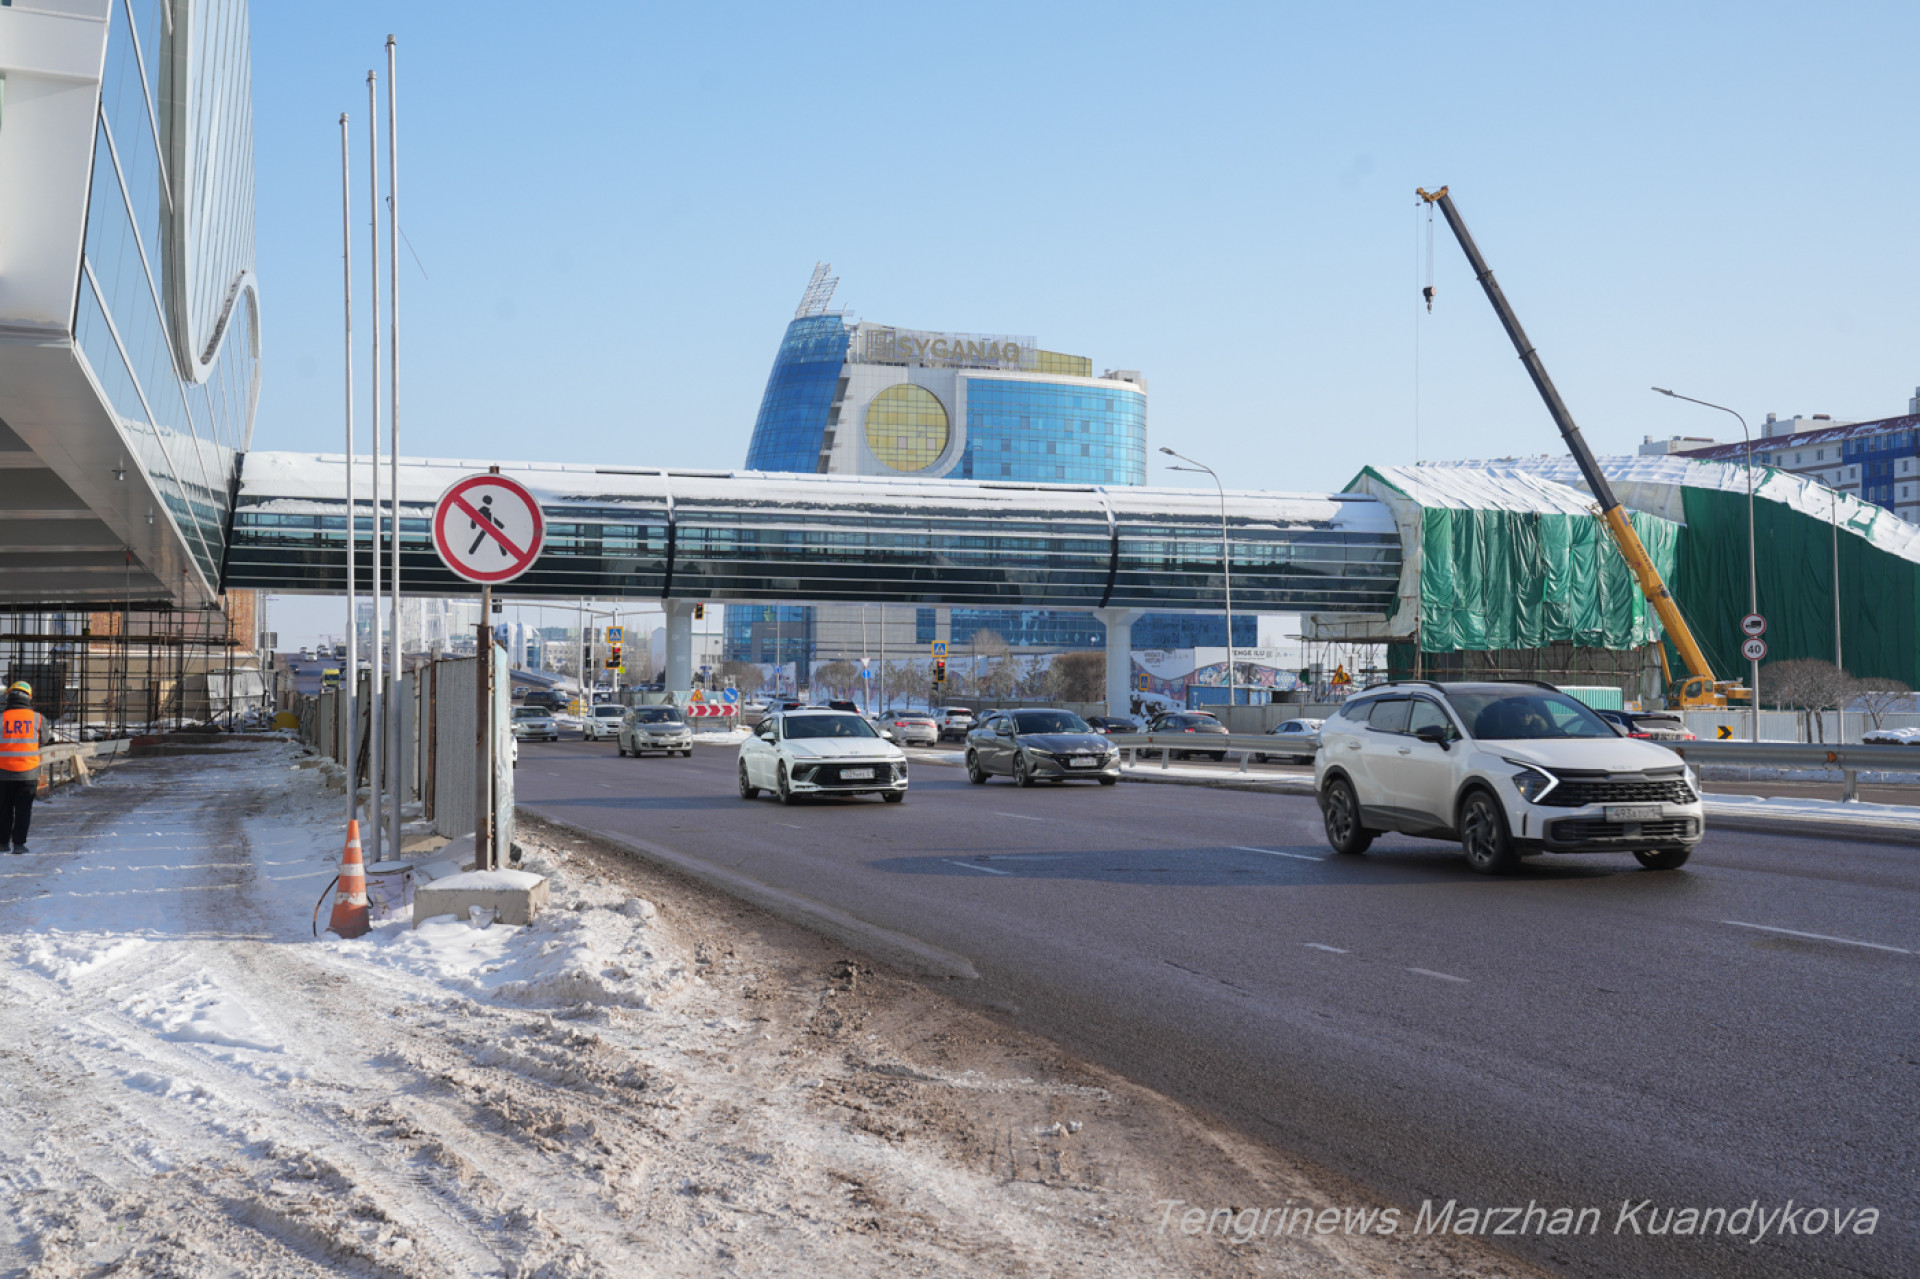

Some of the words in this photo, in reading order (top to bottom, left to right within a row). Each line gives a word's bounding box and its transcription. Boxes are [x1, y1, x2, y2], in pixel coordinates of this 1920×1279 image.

[899, 336, 1020, 362] SYGANAQ
[1747, 644, 1762, 654] 40
[5, 720, 32, 734] LRT
